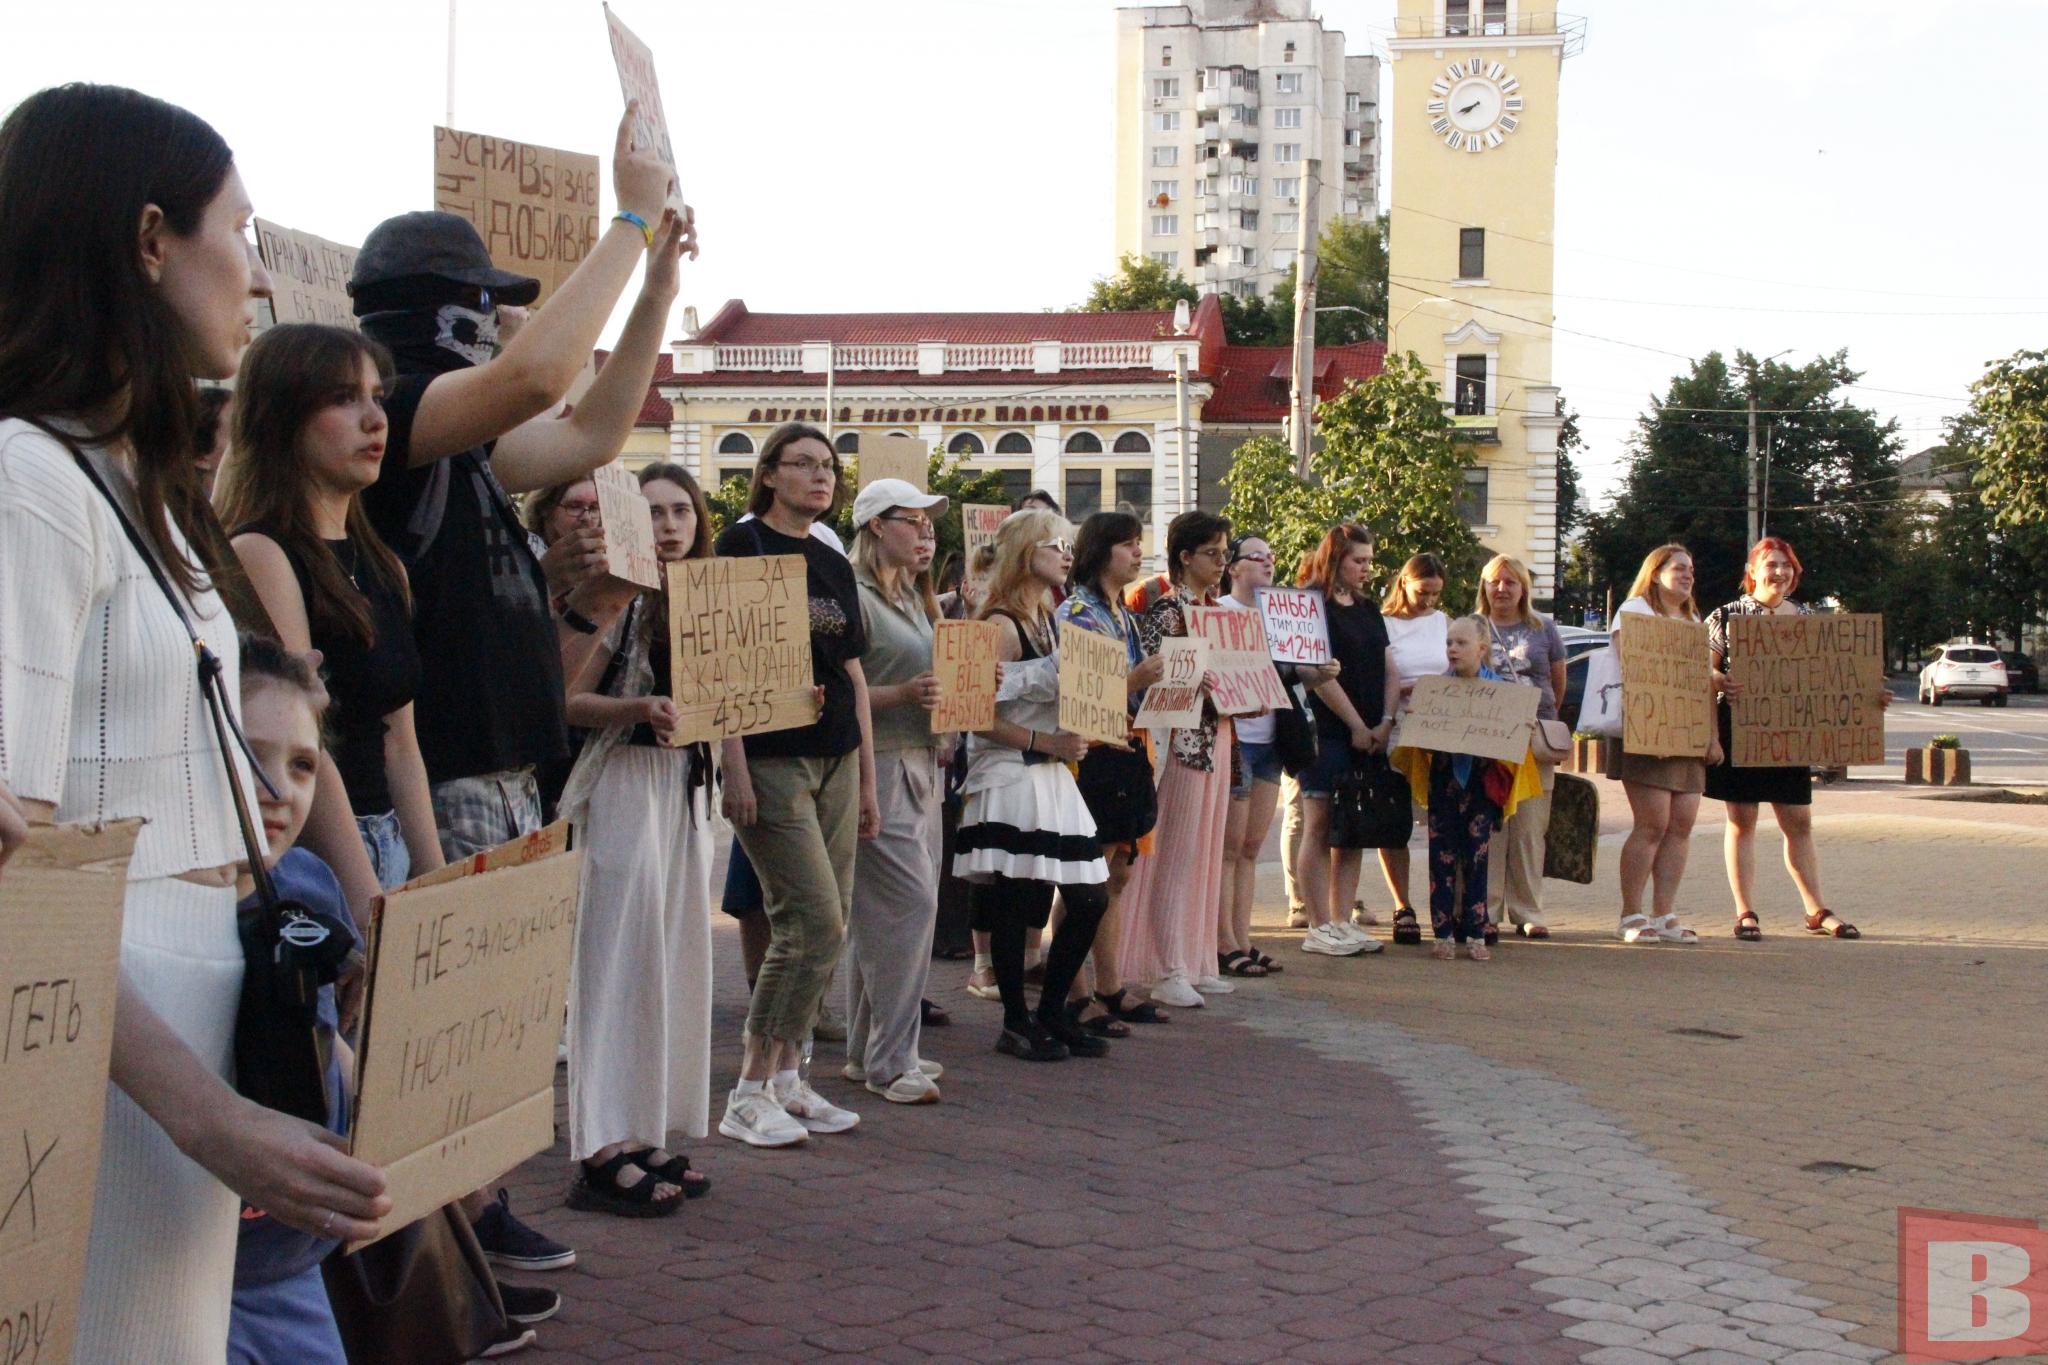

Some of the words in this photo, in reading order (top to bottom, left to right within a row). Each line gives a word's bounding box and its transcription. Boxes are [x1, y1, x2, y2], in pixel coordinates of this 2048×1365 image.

[435, 127, 515, 173] РУСНЯ
[863, 408, 986, 422] КІНОТЕАТР
[995, 405, 1109, 421] ПЛАНЕТА
[966, 509, 978, 530] НЕ
[686, 560, 731, 611] МИ
[750, 558, 789, 604] ЗА
[1260, 591, 1319, 619] АНЬБА
[680, 603, 788, 657] НЕГАЙНЕ
[1269, 618, 1293, 632] ТИМ
[1296, 621, 1314, 633] ХТО
[1816, 618, 1877, 656] МЕНІ
[1170, 648, 1197, 680] 4555
[1277, 634, 1327, 660] #12414
[680, 641, 812, 704] СКАСУВАННЯ
[956, 661, 982, 694] ВІД
[1077, 670, 1103, 701] АБО
[712, 689, 774, 736] 4555
[1061, 696, 1125, 740] ПОМРЕМО
[1420, 719, 1451, 731] not
[1624, 691, 1705, 749] КРАДЕ
[1737, 696, 1771, 727] ЩО
[1779, 692, 1863, 727] ПРАЦЮЄ
[1744, 729, 1820, 763] ПРОТИ
[1820, 726, 1880, 763] МЕНЕ
[412, 912, 454, 990] НЕ
[4, 979, 82, 1064] ГЕТЬ
